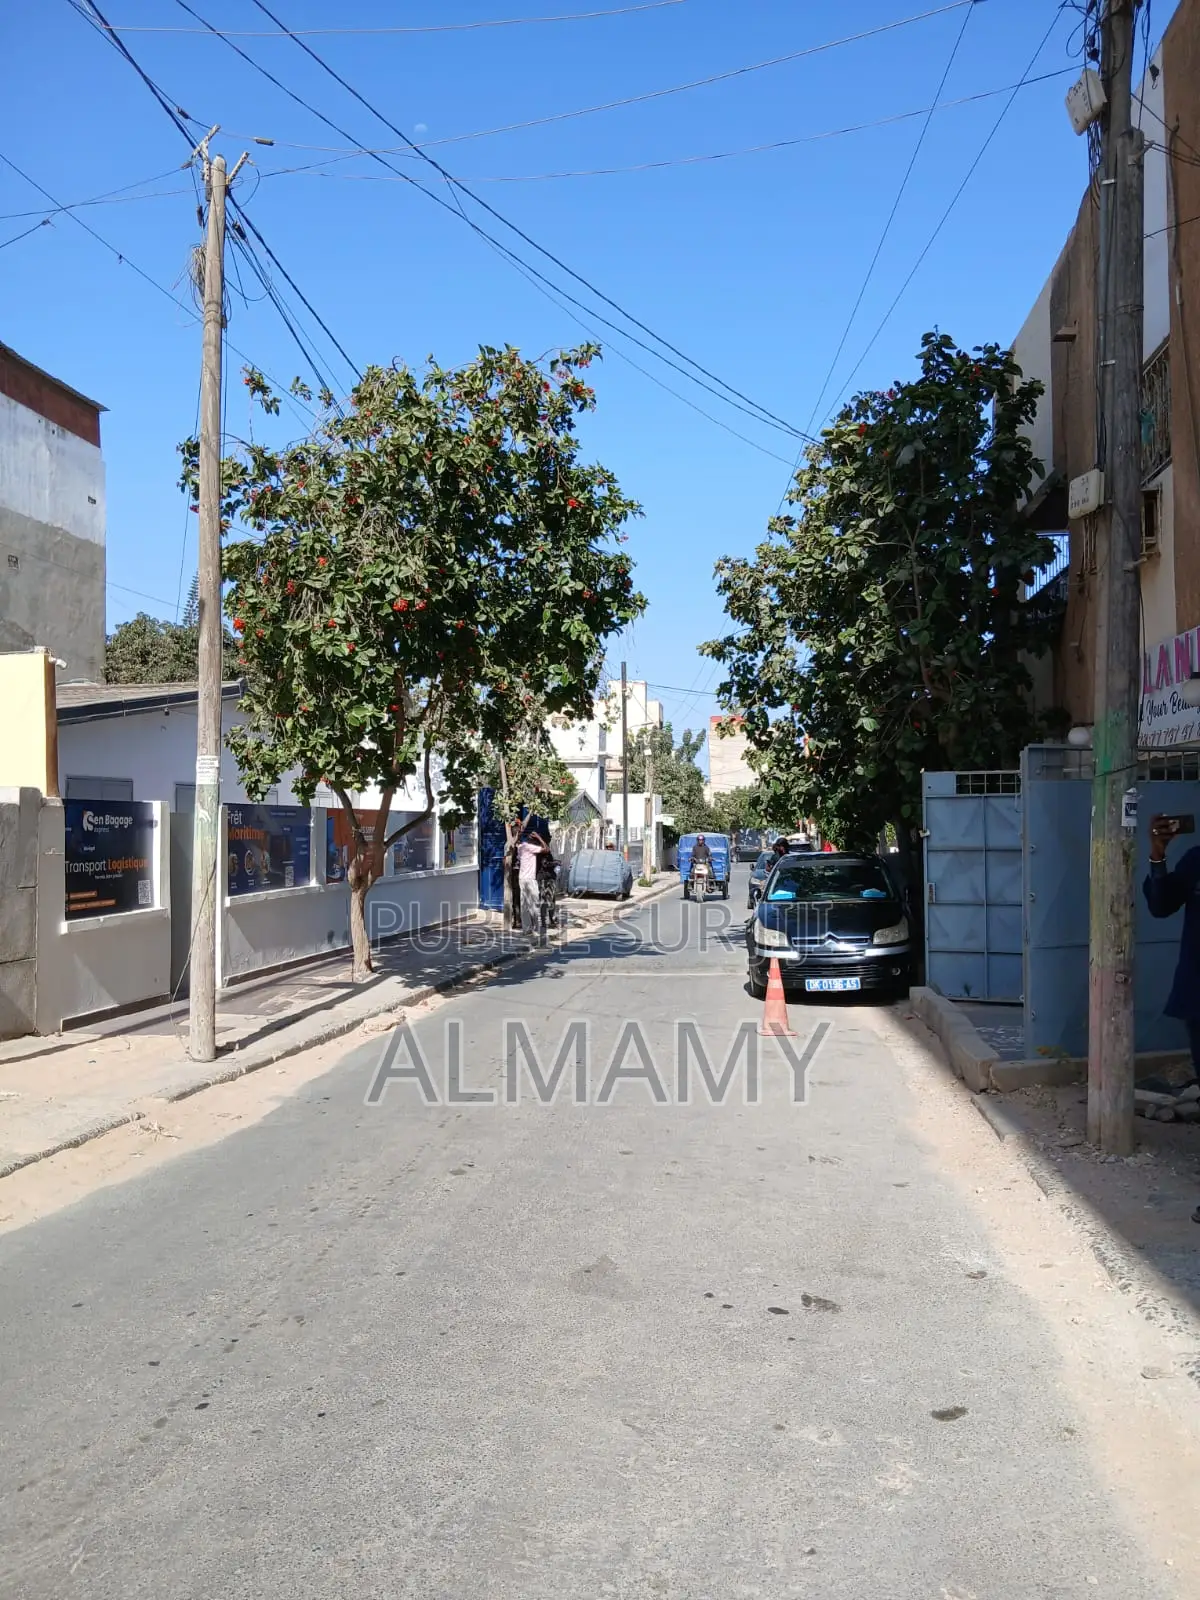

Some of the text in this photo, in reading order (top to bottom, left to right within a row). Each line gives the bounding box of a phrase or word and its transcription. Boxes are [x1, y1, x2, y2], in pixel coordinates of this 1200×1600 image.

[1143, 627, 1200, 694] LAN
[105, 814, 133, 828] Bagage
[65, 859, 107, 876] Transport
